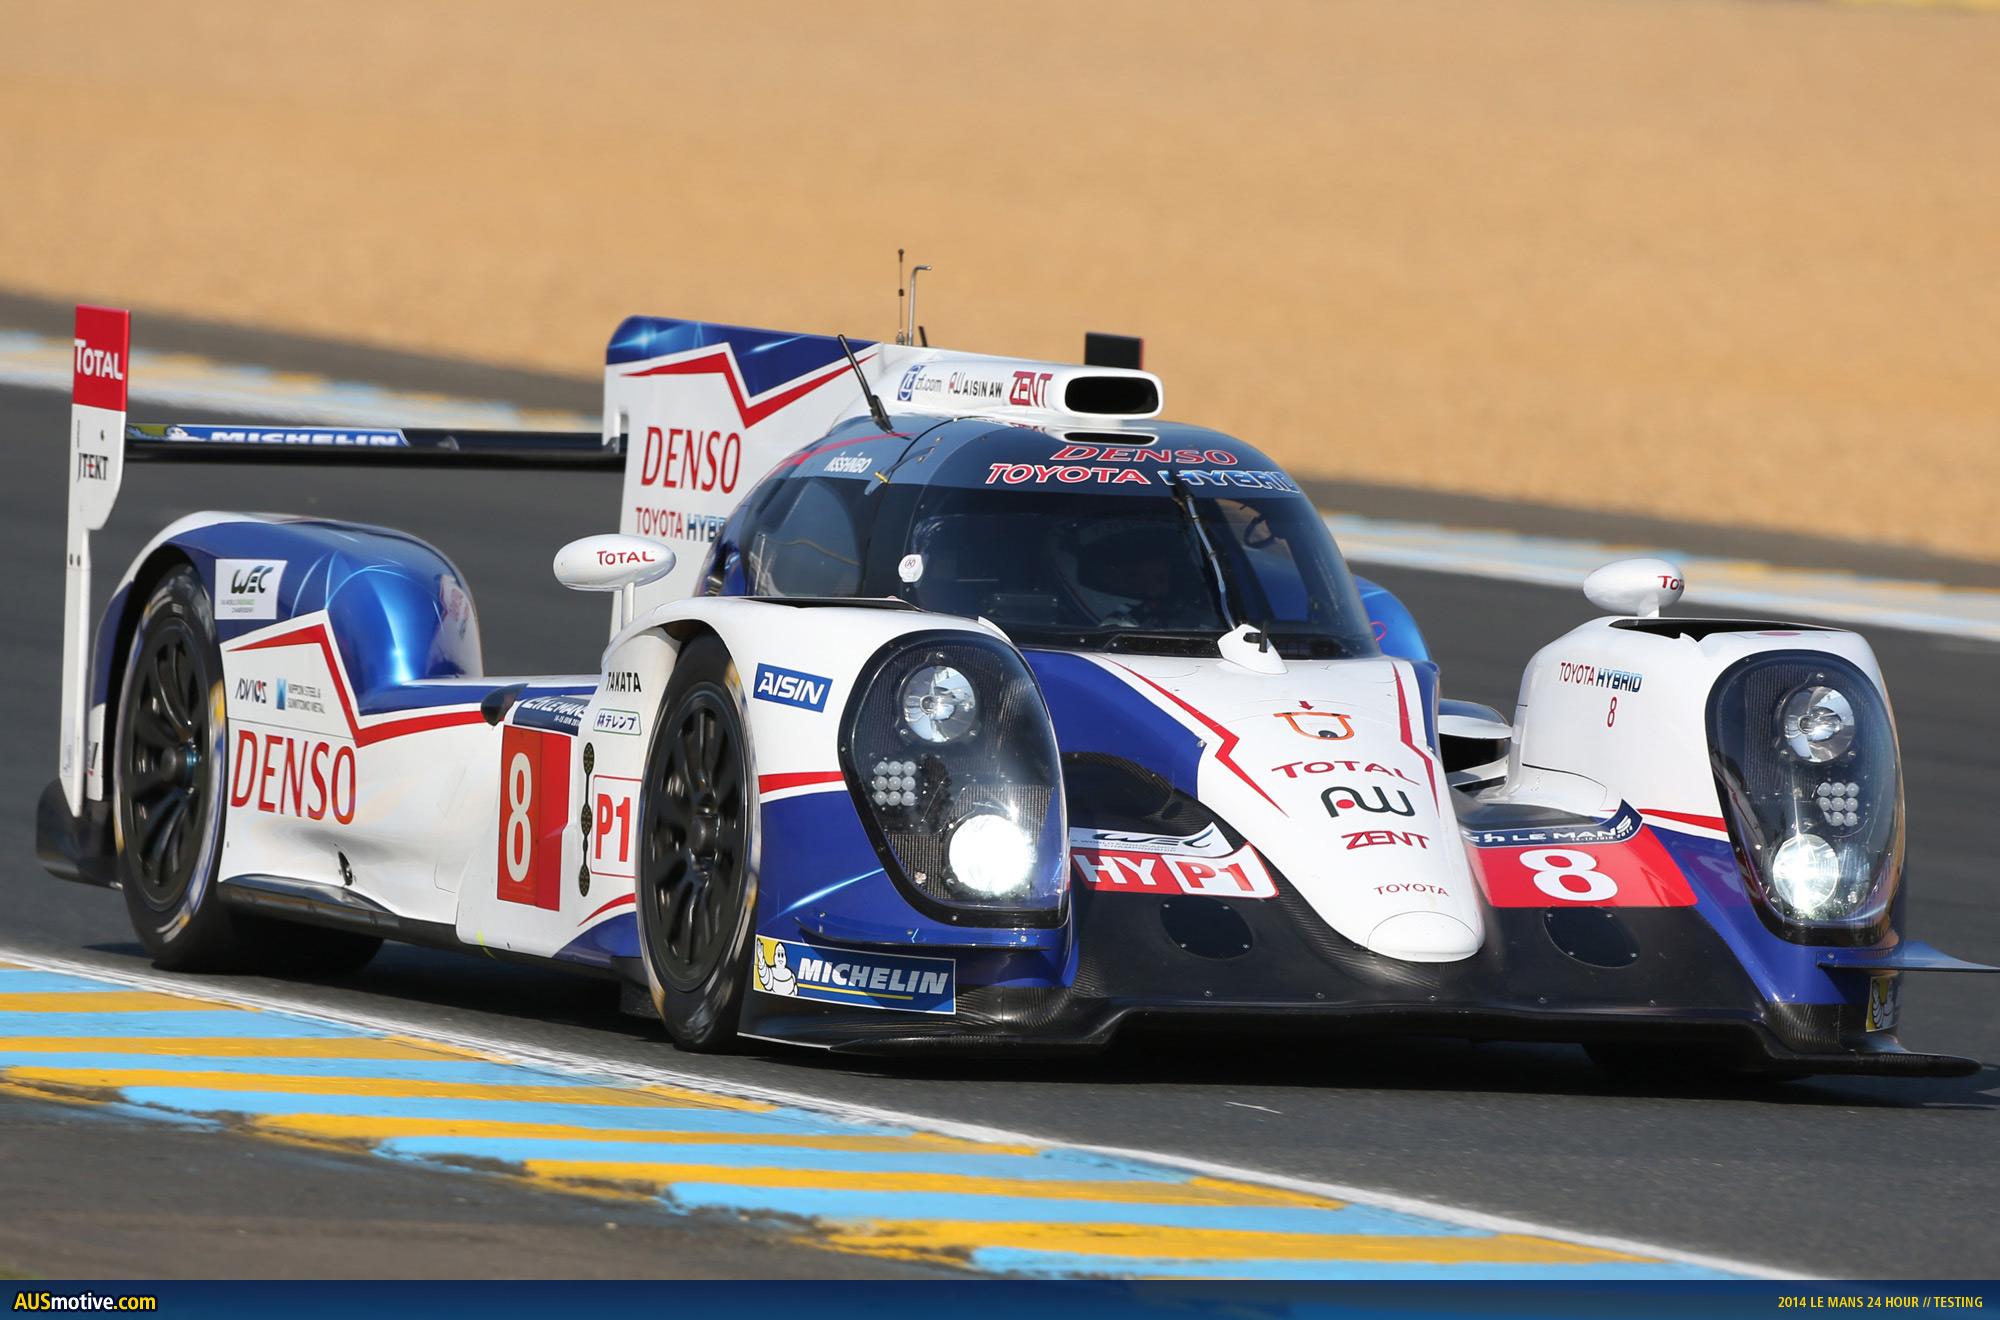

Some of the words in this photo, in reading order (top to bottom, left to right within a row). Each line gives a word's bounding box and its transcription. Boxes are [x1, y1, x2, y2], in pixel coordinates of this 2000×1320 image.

[74, 338, 123, 380] TOTAL
[963, 380, 988, 397] AISIN
[988, 382, 1004, 398] AW
[1008, 370, 1054, 408] ZENT
[210, 430, 398, 447] MICHELIN
[77, 452, 109, 482] JTEKT
[641, 425, 741, 495] DENSO
[1049, 444, 1239, 465] DENSO
[985, 463, 1152, 485] TOYOTA
[635, 506, 684, 540] TOYOTA
[596, 550, 656, 566] TOTAL
[231, 565, 275, 594] WEC
[605, 671, 642, 693] TAKATA
[756, 671, 827, 706] AISIN
[1559, 661, 1596, 686] TOYOTA
[1595, 667, 1643, 692] HYBRID
[597, 713, 637, 731] 林テレンプ
[1606, 696, 1618, 728] 8
[230, 729, 357, 825] DENSO
[1271, 760, 1421, 786] TOTAL
[507, 752, 532, 883] 8
[595, 793, 631, 863] P1
[1512, 833, 1547, 842] LE
[1553, 815, 1632, 839] MANS
[1341, 830, 1430, 850] ZENT
[1072, 854, 1158, 886] HY
[1175, 860, 1255, 892] P1
[1519, 848, 1619, 902] 8
[1374, 883, 1450, 897] TOYOTA
[797, 956, 950, 995] MICHELIN
